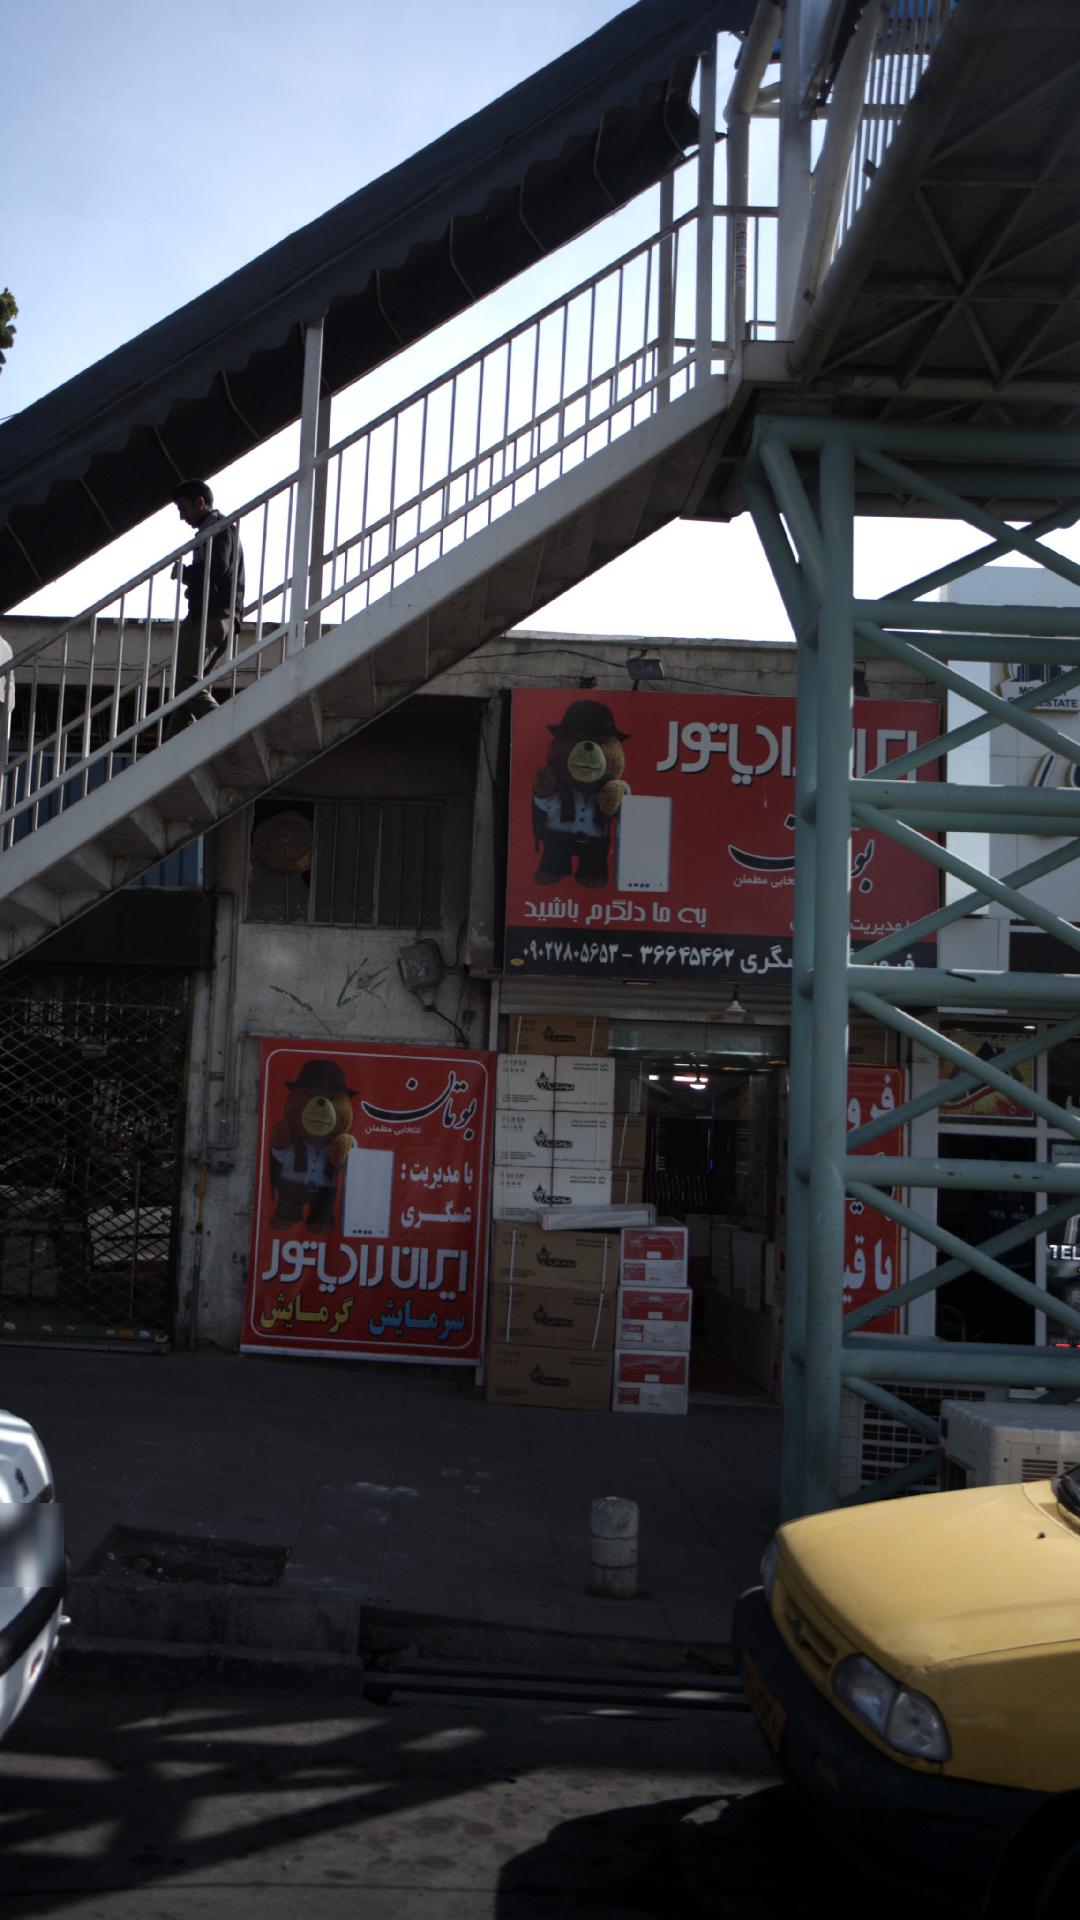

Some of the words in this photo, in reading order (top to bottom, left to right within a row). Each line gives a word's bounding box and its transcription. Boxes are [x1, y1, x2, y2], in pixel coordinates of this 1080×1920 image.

[656, 720, 796, 786] ادیاتور
[524, 896, 579, 923] باشید
[585, 899, 646, 926] دلگرم
[652, 901, 672, 923] ما
[677, 906, 707, 928] به
[523, 938, 620, 964] ۰۹۰۲۷۸۰۵۶۵۳
[640, 944, 736, 968] ۳۶۶۴۵۴۶۲
[740, 944, 793, 975] گری
[360, 1069, 478, 1142] بوتان
[463, 1161, 474, 1190] با
[400, 1199, 473, 1230] عسگری
[262, 1238, 386, 1294] رادیاتور
[389, 1245, 469, 1301] ایران
[260, 1290, 356, 1335] گرمایش
[368, 1299, 466, 1342] سرمایش
